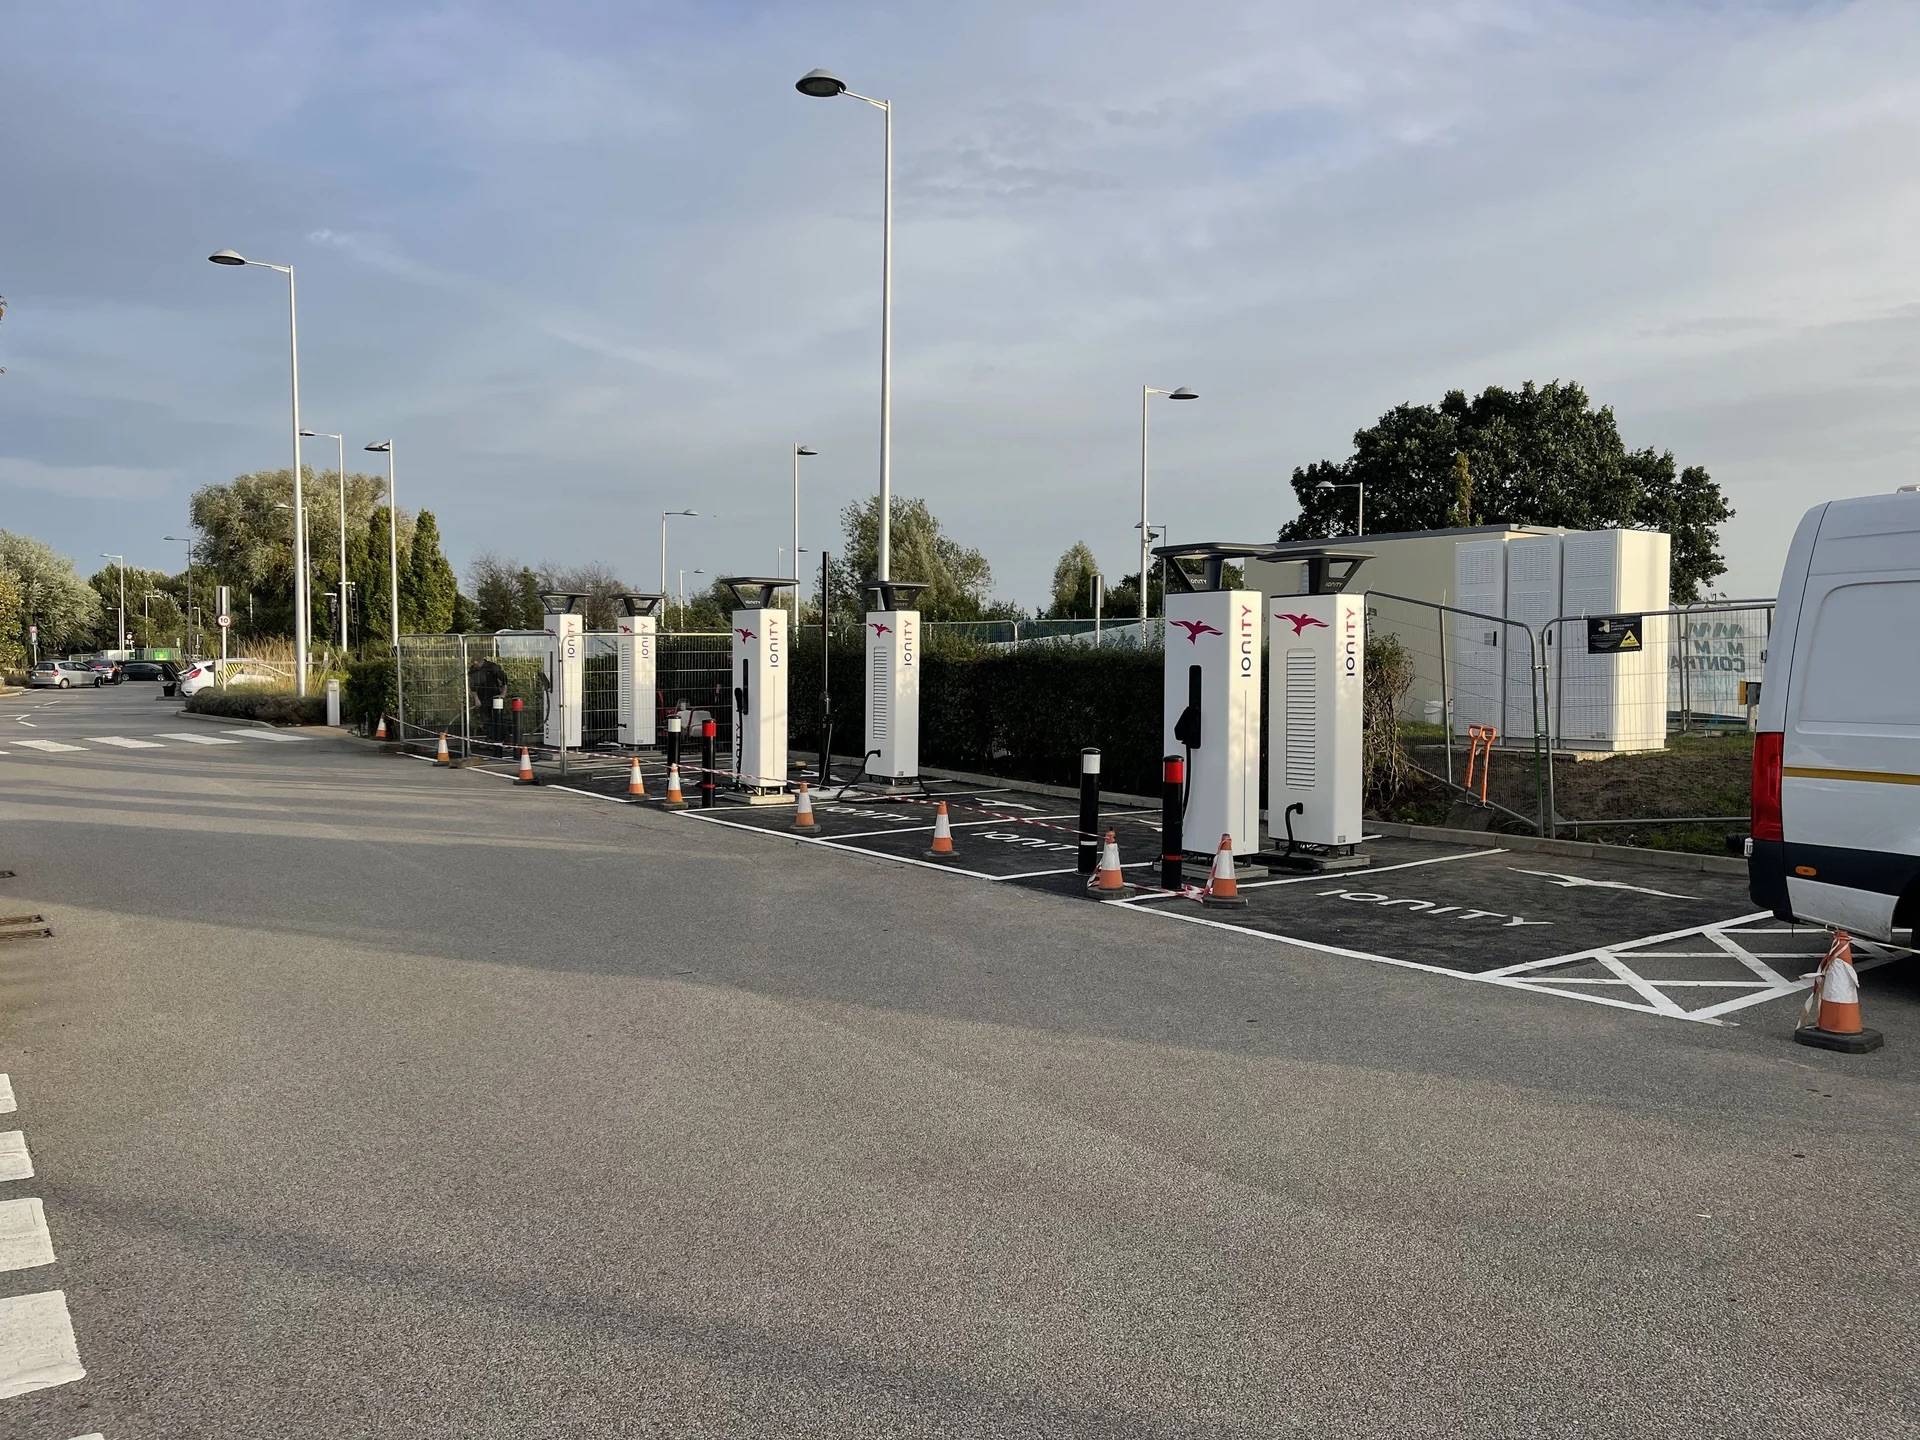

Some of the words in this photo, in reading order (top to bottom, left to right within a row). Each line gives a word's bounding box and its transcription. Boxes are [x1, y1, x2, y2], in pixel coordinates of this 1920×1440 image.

[769, 619, 779, 668] IONITY
[903, 620, 913, 666] IONITY
[1241, 604, 1253, 678] IONITY
[1346, 607, 1356, 677] IONITY
[816, 805, 923, 822] IONITY
[970, 830, 1080, 855] IONIT
[1316, 888, 1555, 928] IONITY
